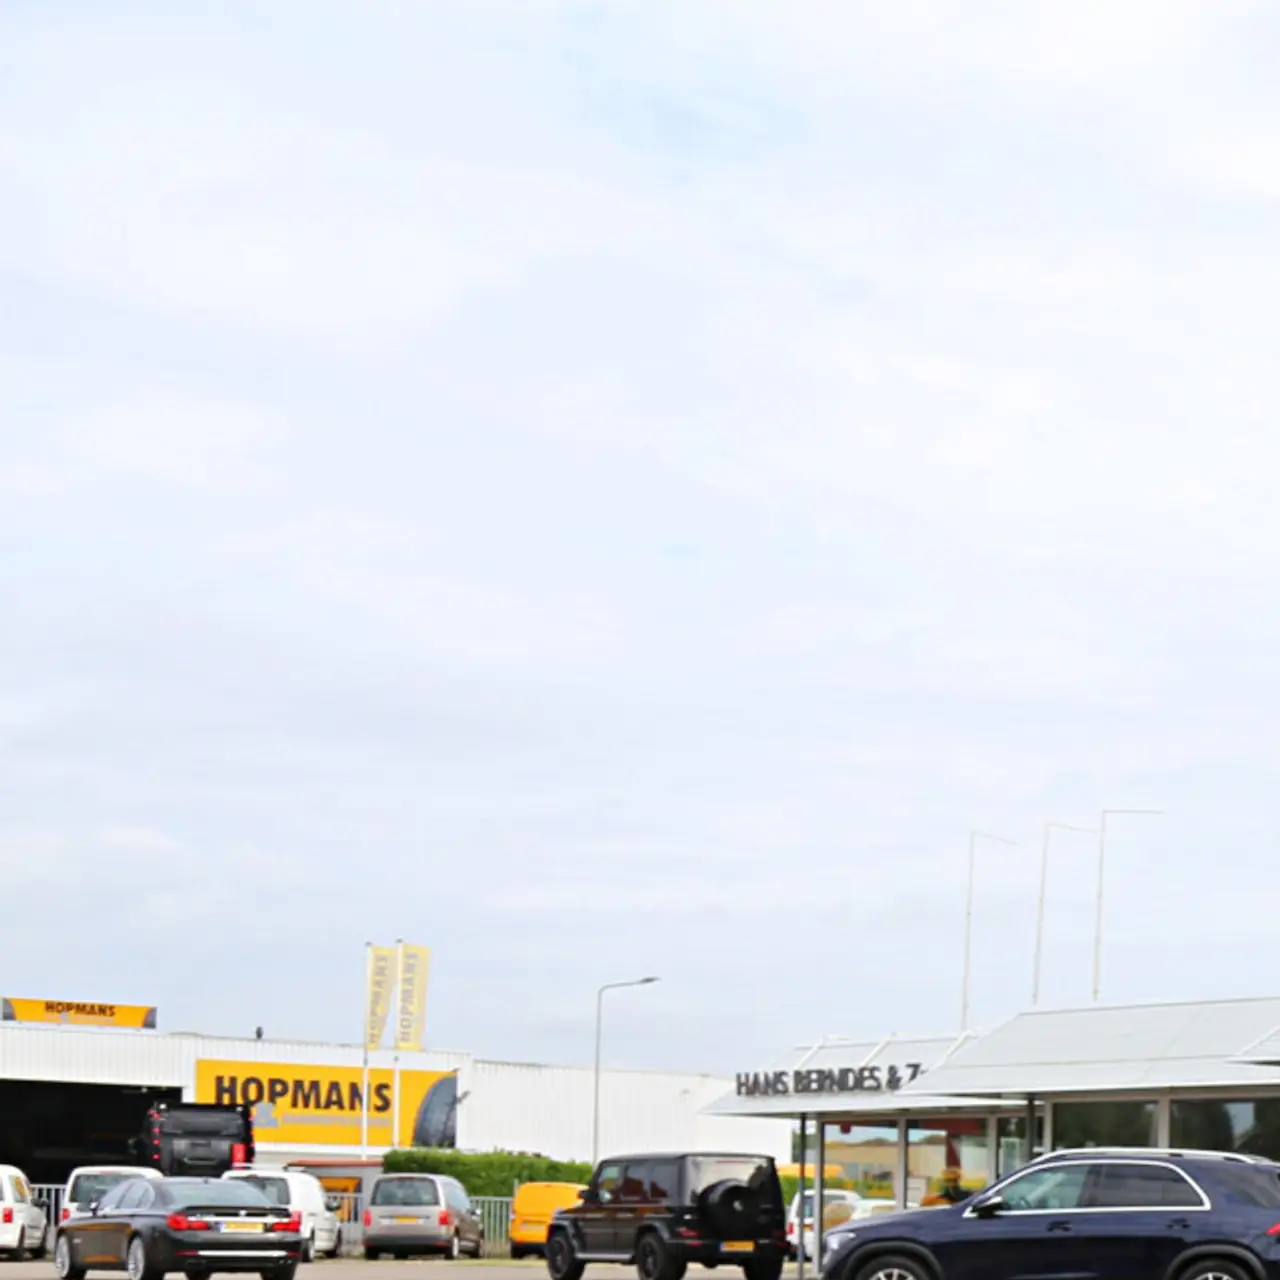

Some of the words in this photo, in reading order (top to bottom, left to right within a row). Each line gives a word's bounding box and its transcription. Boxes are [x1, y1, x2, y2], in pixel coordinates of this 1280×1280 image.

[45, 1001, 116, 1017] HOPMANS
[214, 1075, 392, 1112] HOPMANS
[736, 1071, 788, 1096] HANS
